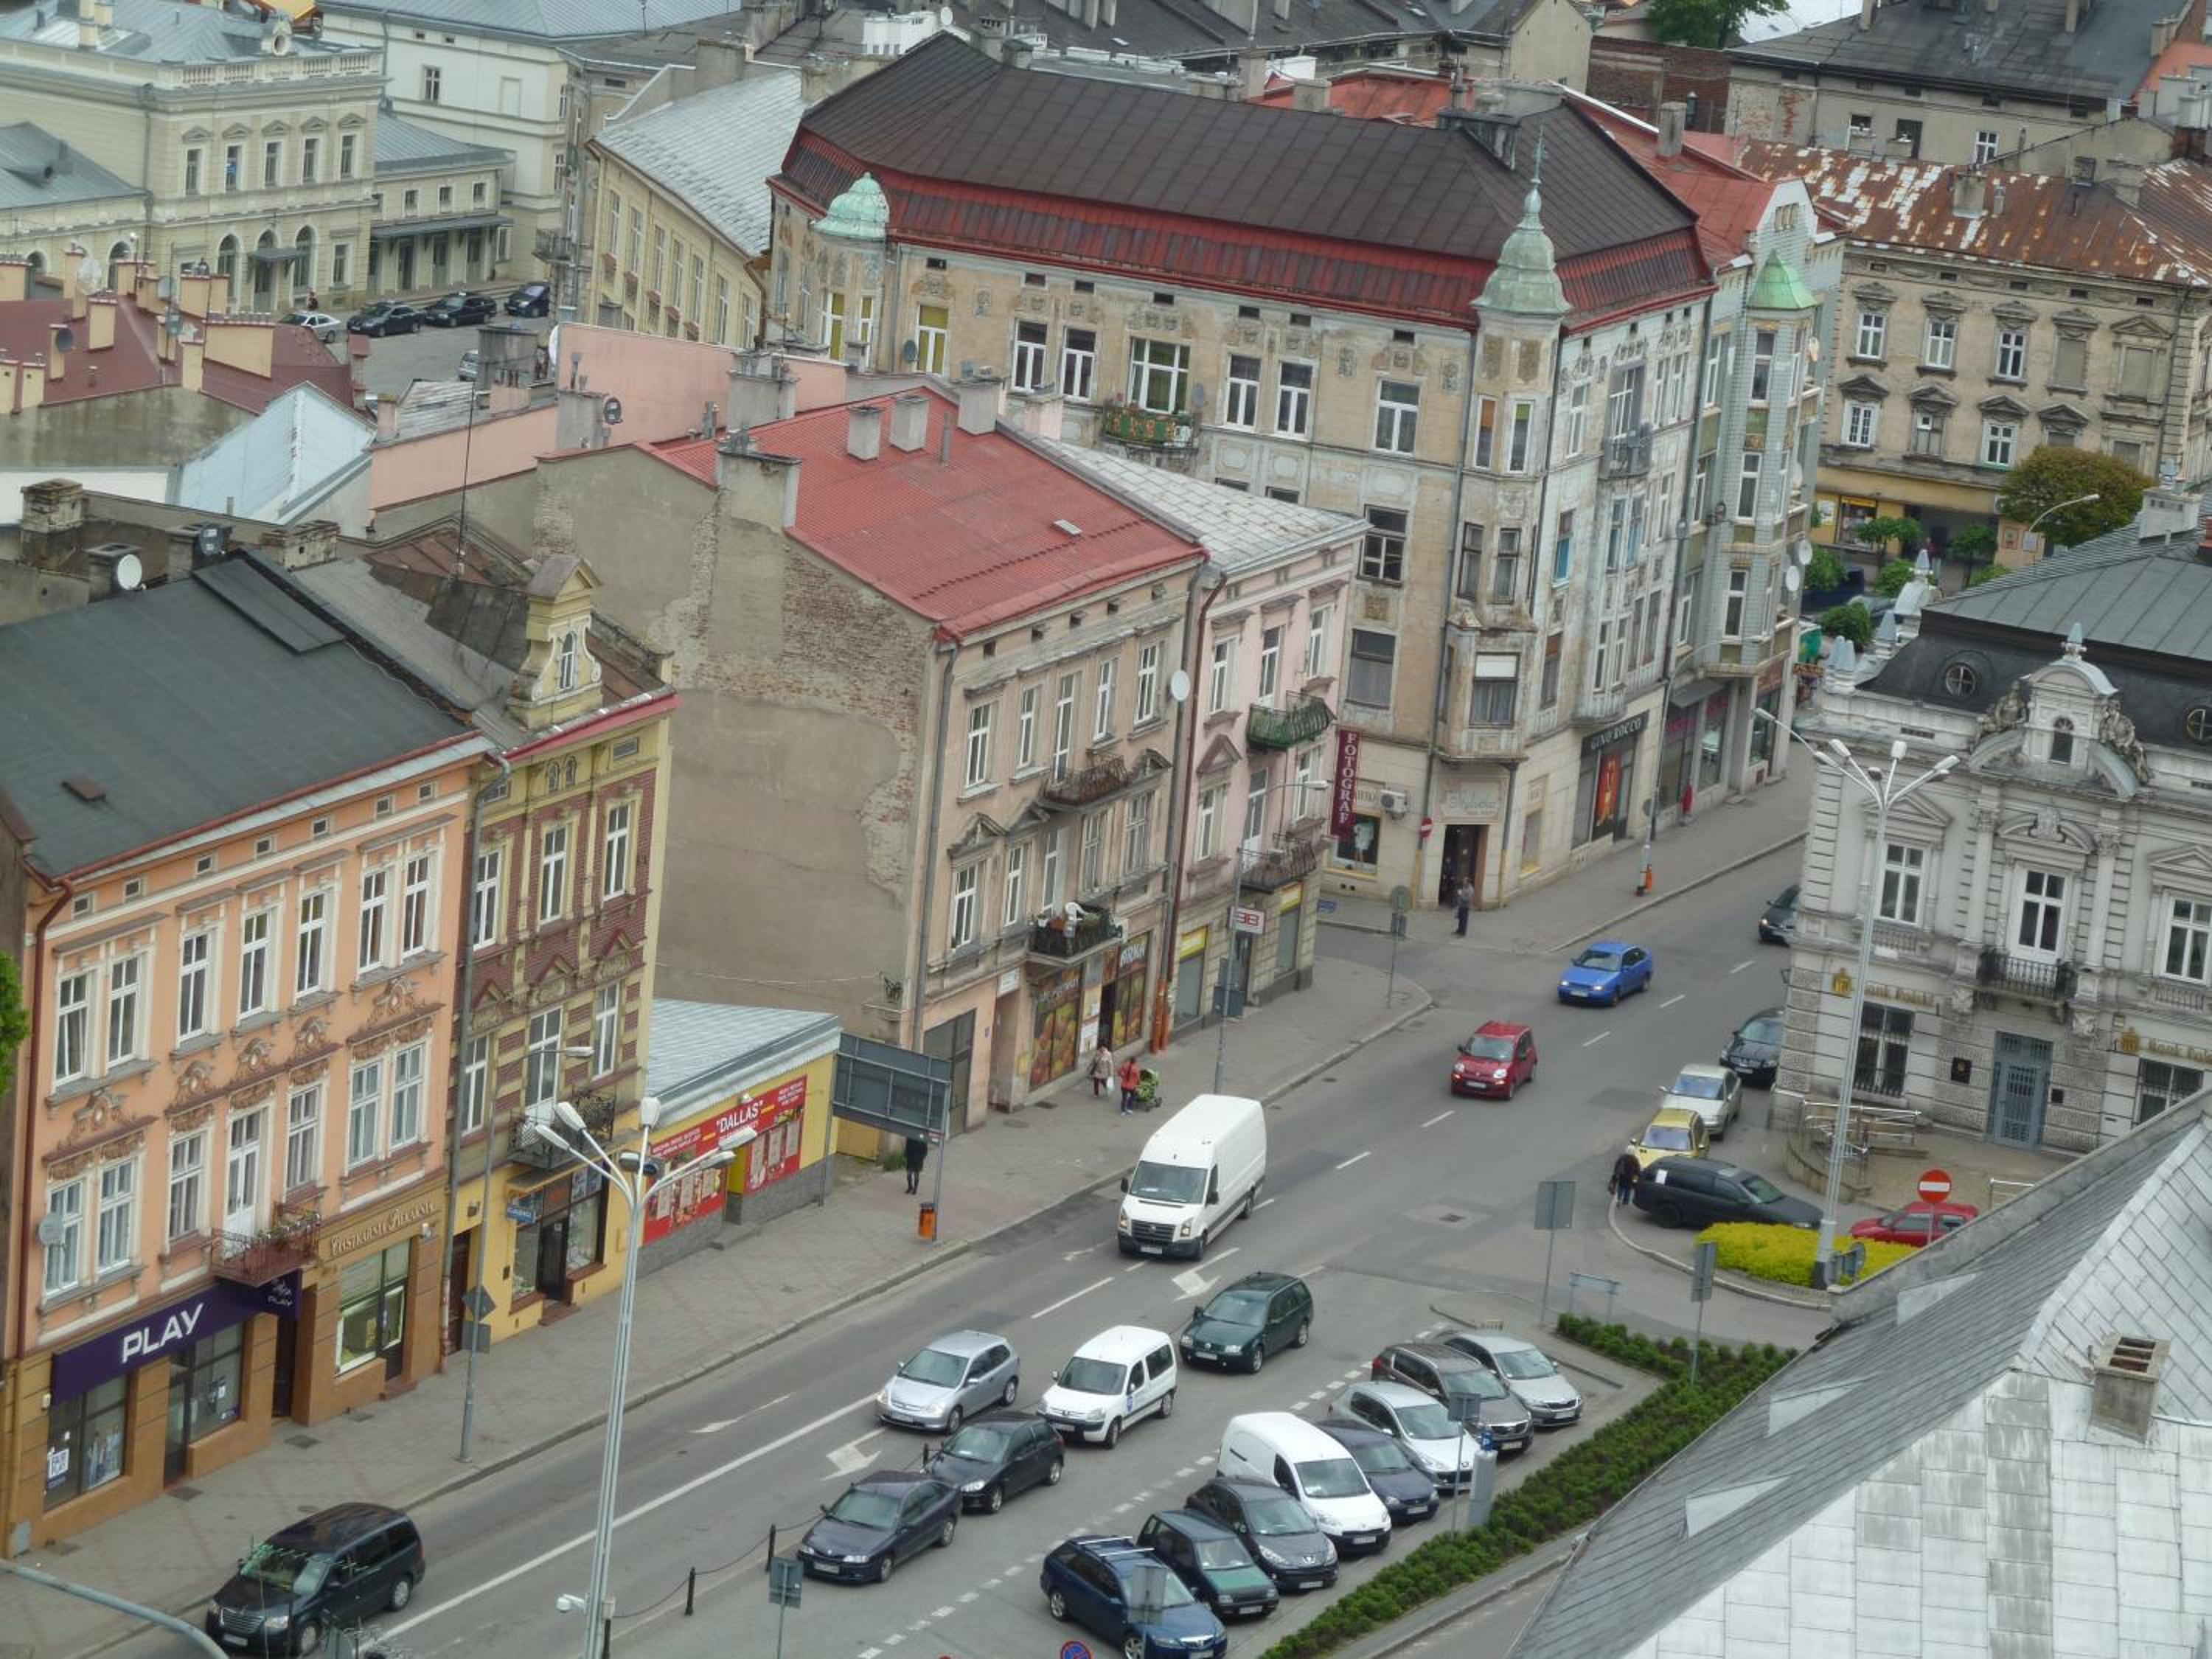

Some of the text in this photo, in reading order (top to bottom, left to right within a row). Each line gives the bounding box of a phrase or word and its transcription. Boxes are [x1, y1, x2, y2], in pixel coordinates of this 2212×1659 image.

[1340, 733, 1357, 824] FOTOGRAF
[716, 1099, 764, 1133] "DALLAS"
[122, 1303, 204, 1363] PLAY
